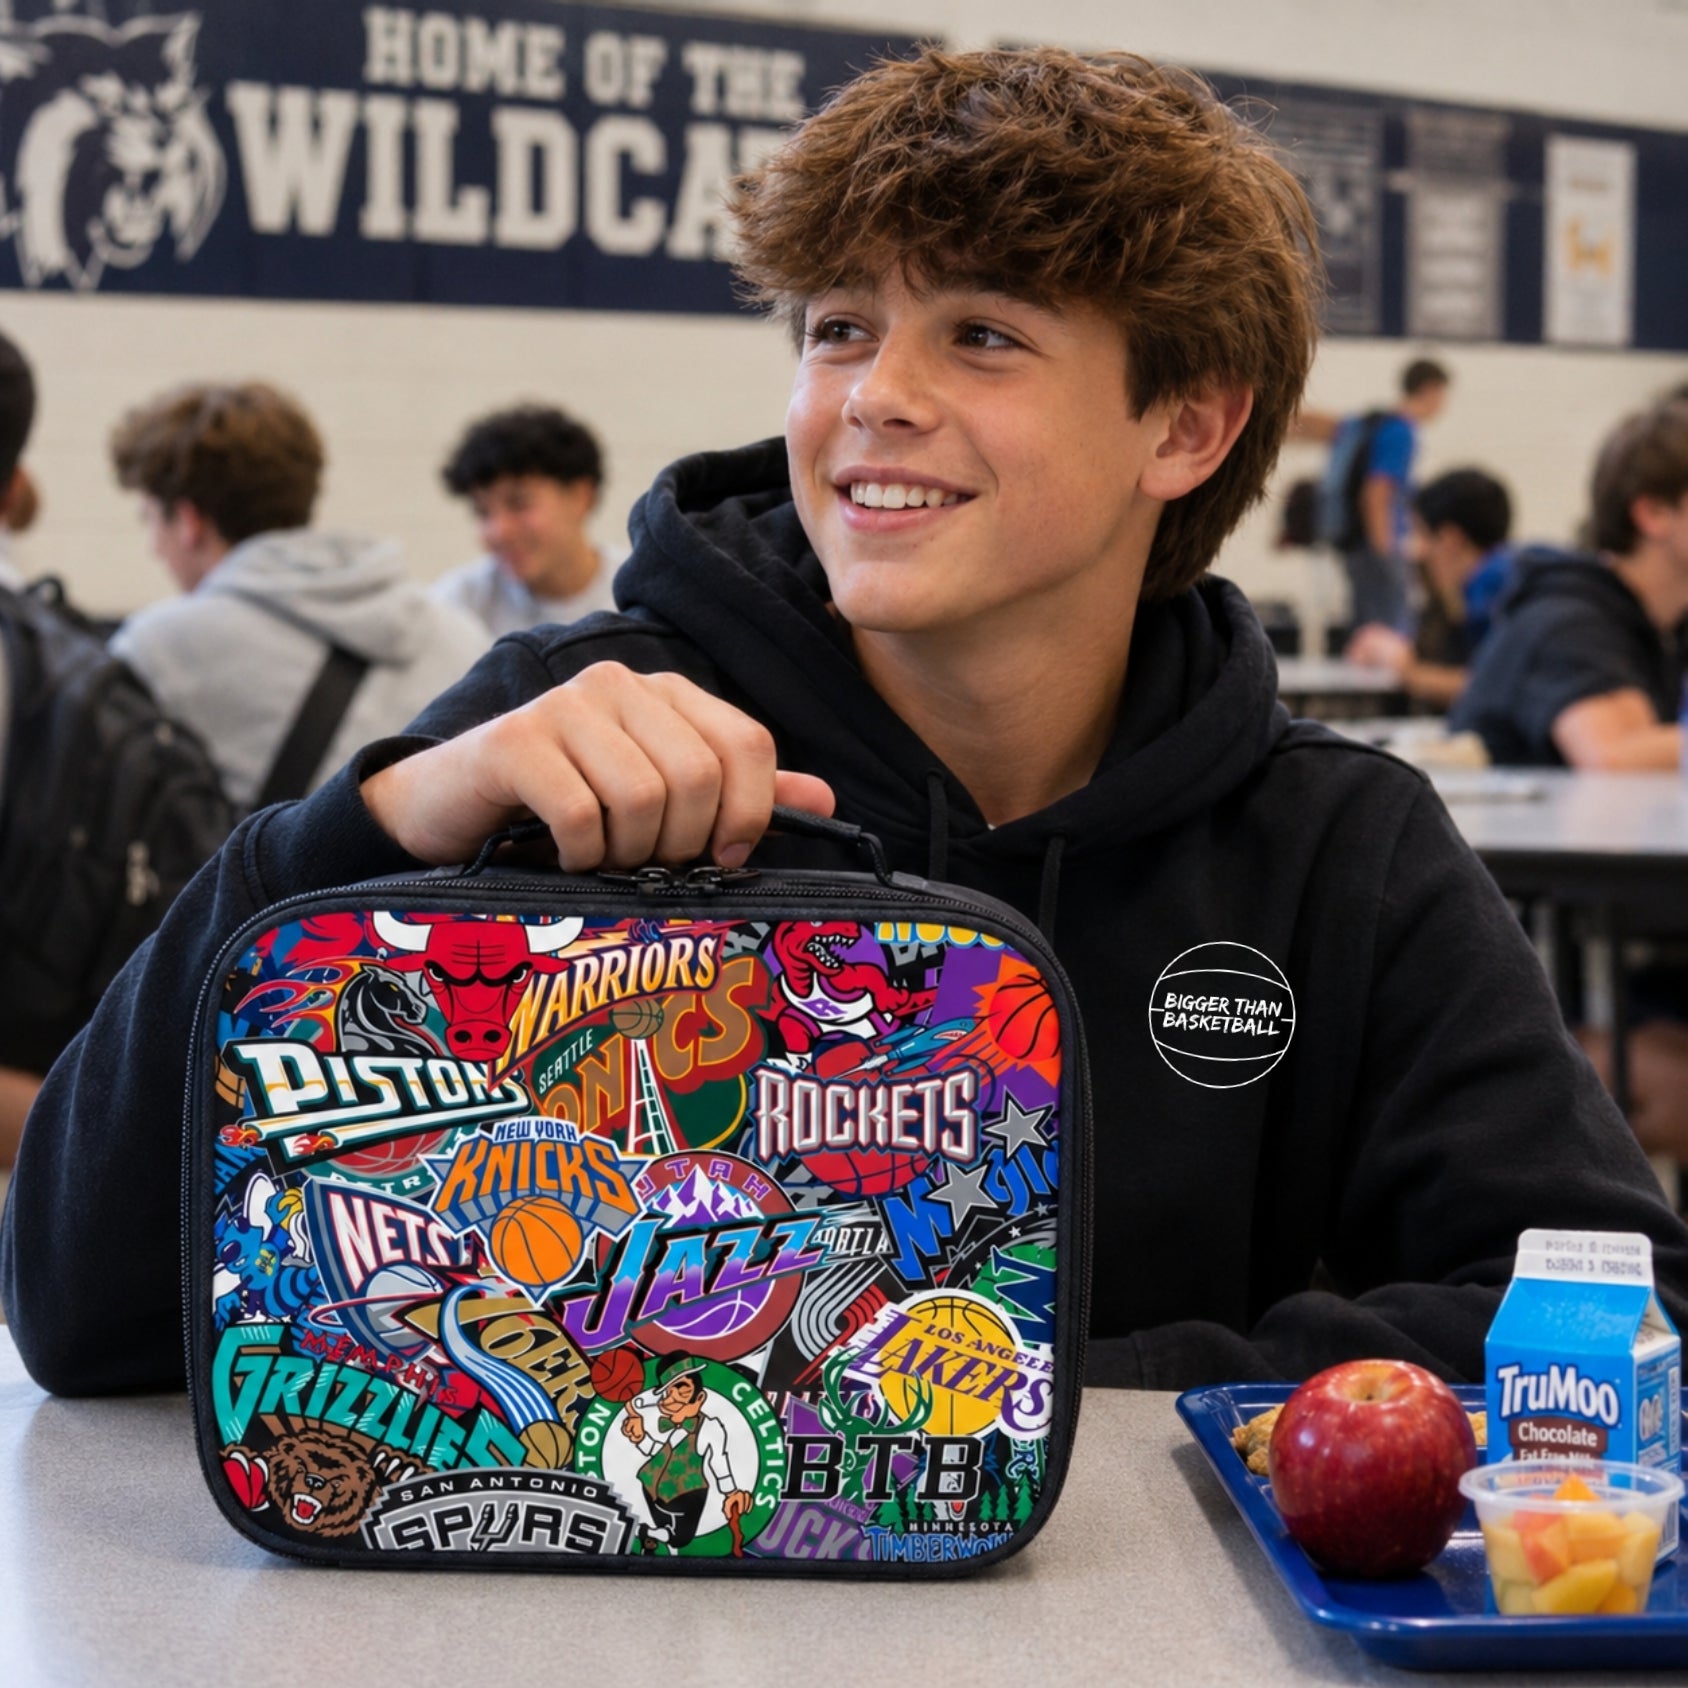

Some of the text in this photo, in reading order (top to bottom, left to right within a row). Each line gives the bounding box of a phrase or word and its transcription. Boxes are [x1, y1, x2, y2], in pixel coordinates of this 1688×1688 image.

[364, 8, 806, 123] HOME OF THE
[226, 81, 785, 262] WILDCA
[1162, 1011, 1280, 1036] BASKETBALL
[1164, 992, 1283, 1018] BIGGER THAN
[538, 1028, 594, 1095] SEATTLE
[495, 1120, 578, 1142] NEW YORK
[755, 1070, 978, 1162] ROCKETS
[434, 1138, 638, 1215] KNICKS
[635, 1158, 772, 1202] UTAH
[328, 1191, 452, 1293] NETS
[562, 1217, 824, 1349] JAZZ
[300, 1328, 459, 1406] MEMPHIS
[924, 1323, 963, 1344] LOS
[848, 1310, 1054, 1433] LAKERS
[1497, 1363, 1620, 1427] TruMoo
[731, 1381, 784, 1510] CELTICS
[779, 1433, 986, 1501] BTB
[1518, 1422, 1598, 1448] Chocolate
[401, 1475, 598, 1501] SAN ANTONIO
[390, 1501, 609, 1554] SPURS
[908, 1521, 1013, 1533] MINNESOTA
